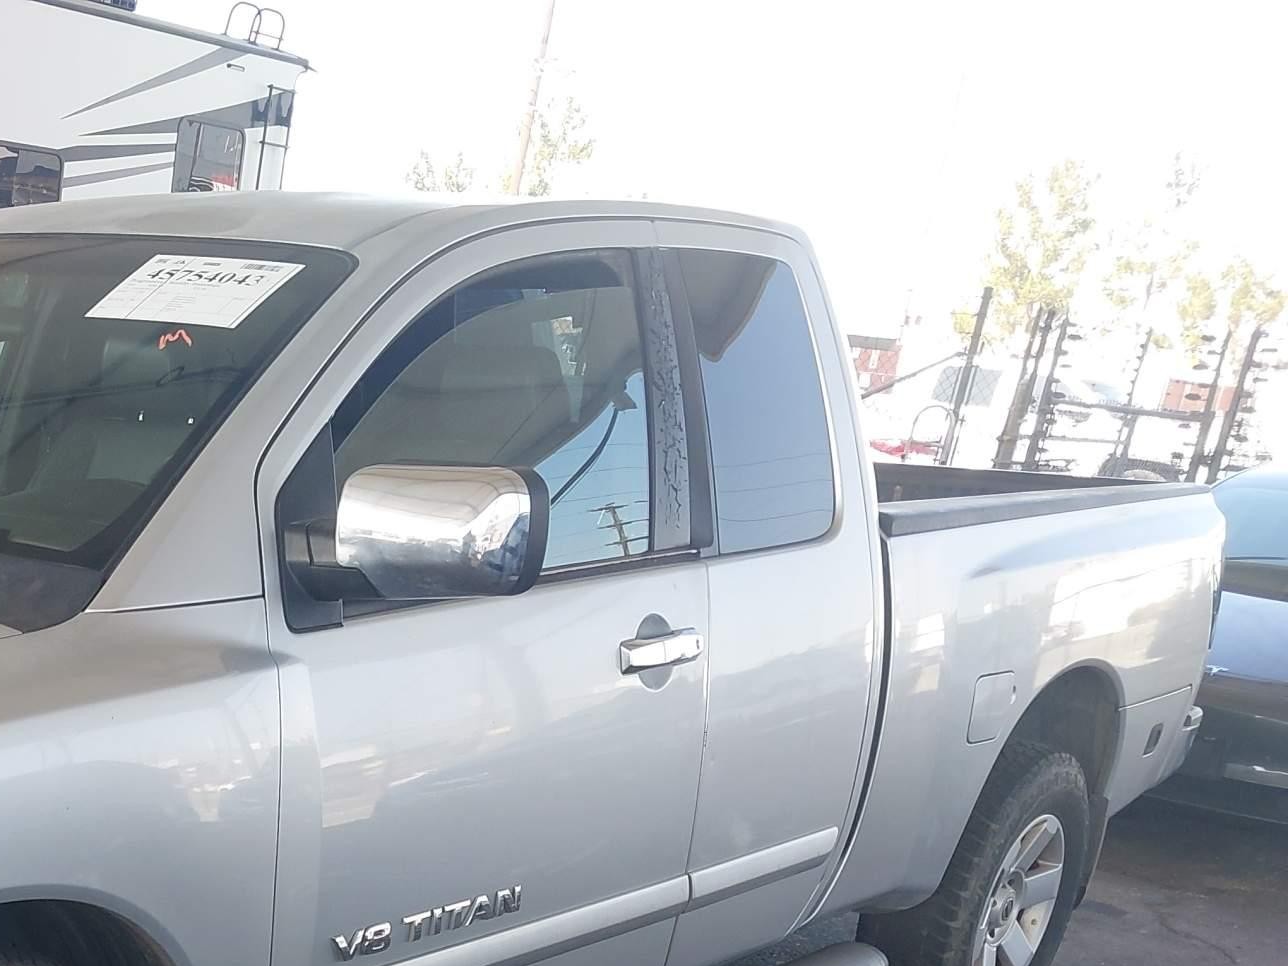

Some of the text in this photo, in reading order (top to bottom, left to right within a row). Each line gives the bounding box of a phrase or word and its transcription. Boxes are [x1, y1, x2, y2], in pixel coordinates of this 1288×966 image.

[147, 268, 266, 287] 45754043
[331, 883, 523, 962] V8 TITAN
